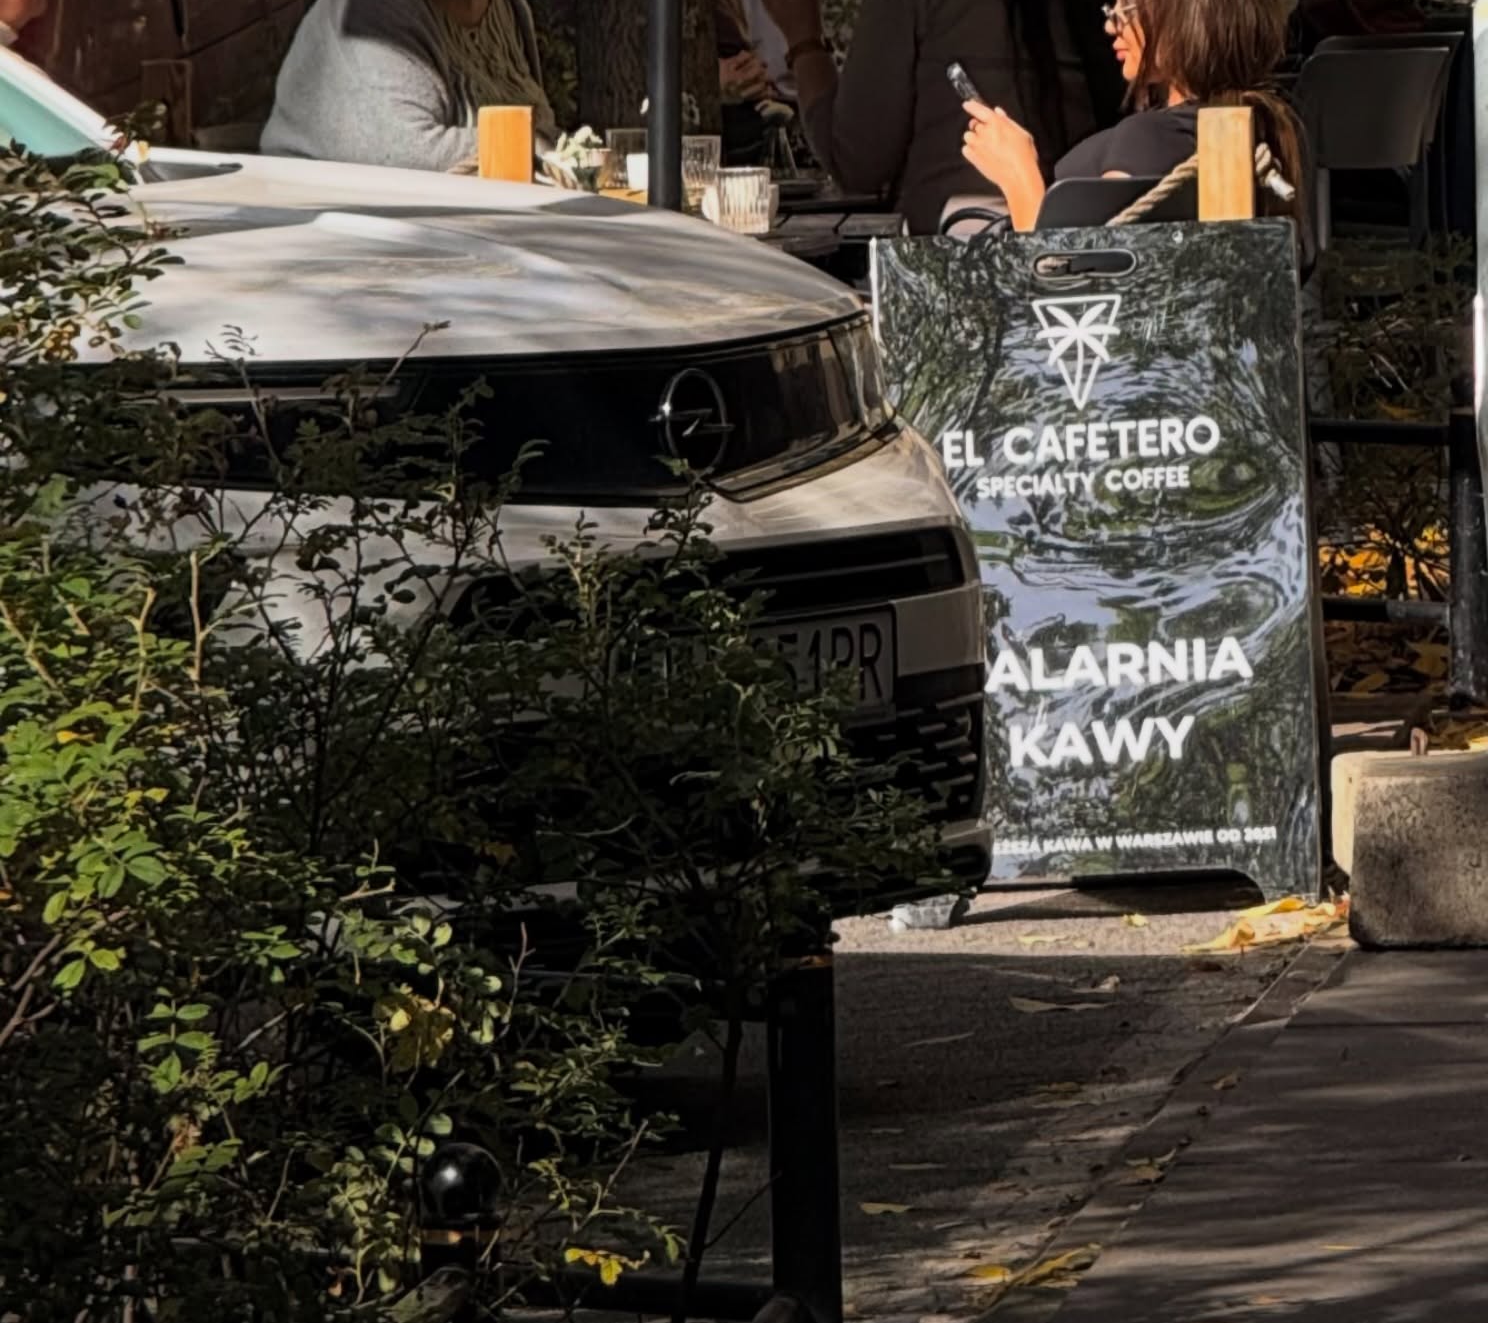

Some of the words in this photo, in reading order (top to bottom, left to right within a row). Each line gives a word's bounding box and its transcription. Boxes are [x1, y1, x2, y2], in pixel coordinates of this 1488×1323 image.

[942, 430, 985, 468] EL
[1003, 415, 1221, 465] CAFETERO
[976, 472, 1095, 500] SPECIALTY
[1104, 466, 1190, 492] COFFEE
[984, 636, 1254, 693] ALARNIA
[1008, 715, 1196, 768] KAWY
[1043, 837, 1094, 853] KAWA
[1095, 835, 1115, 851] W
[1116, 829, 1213, 849] WARSZAWIE
[1216, 828, 1241, 844] OD
